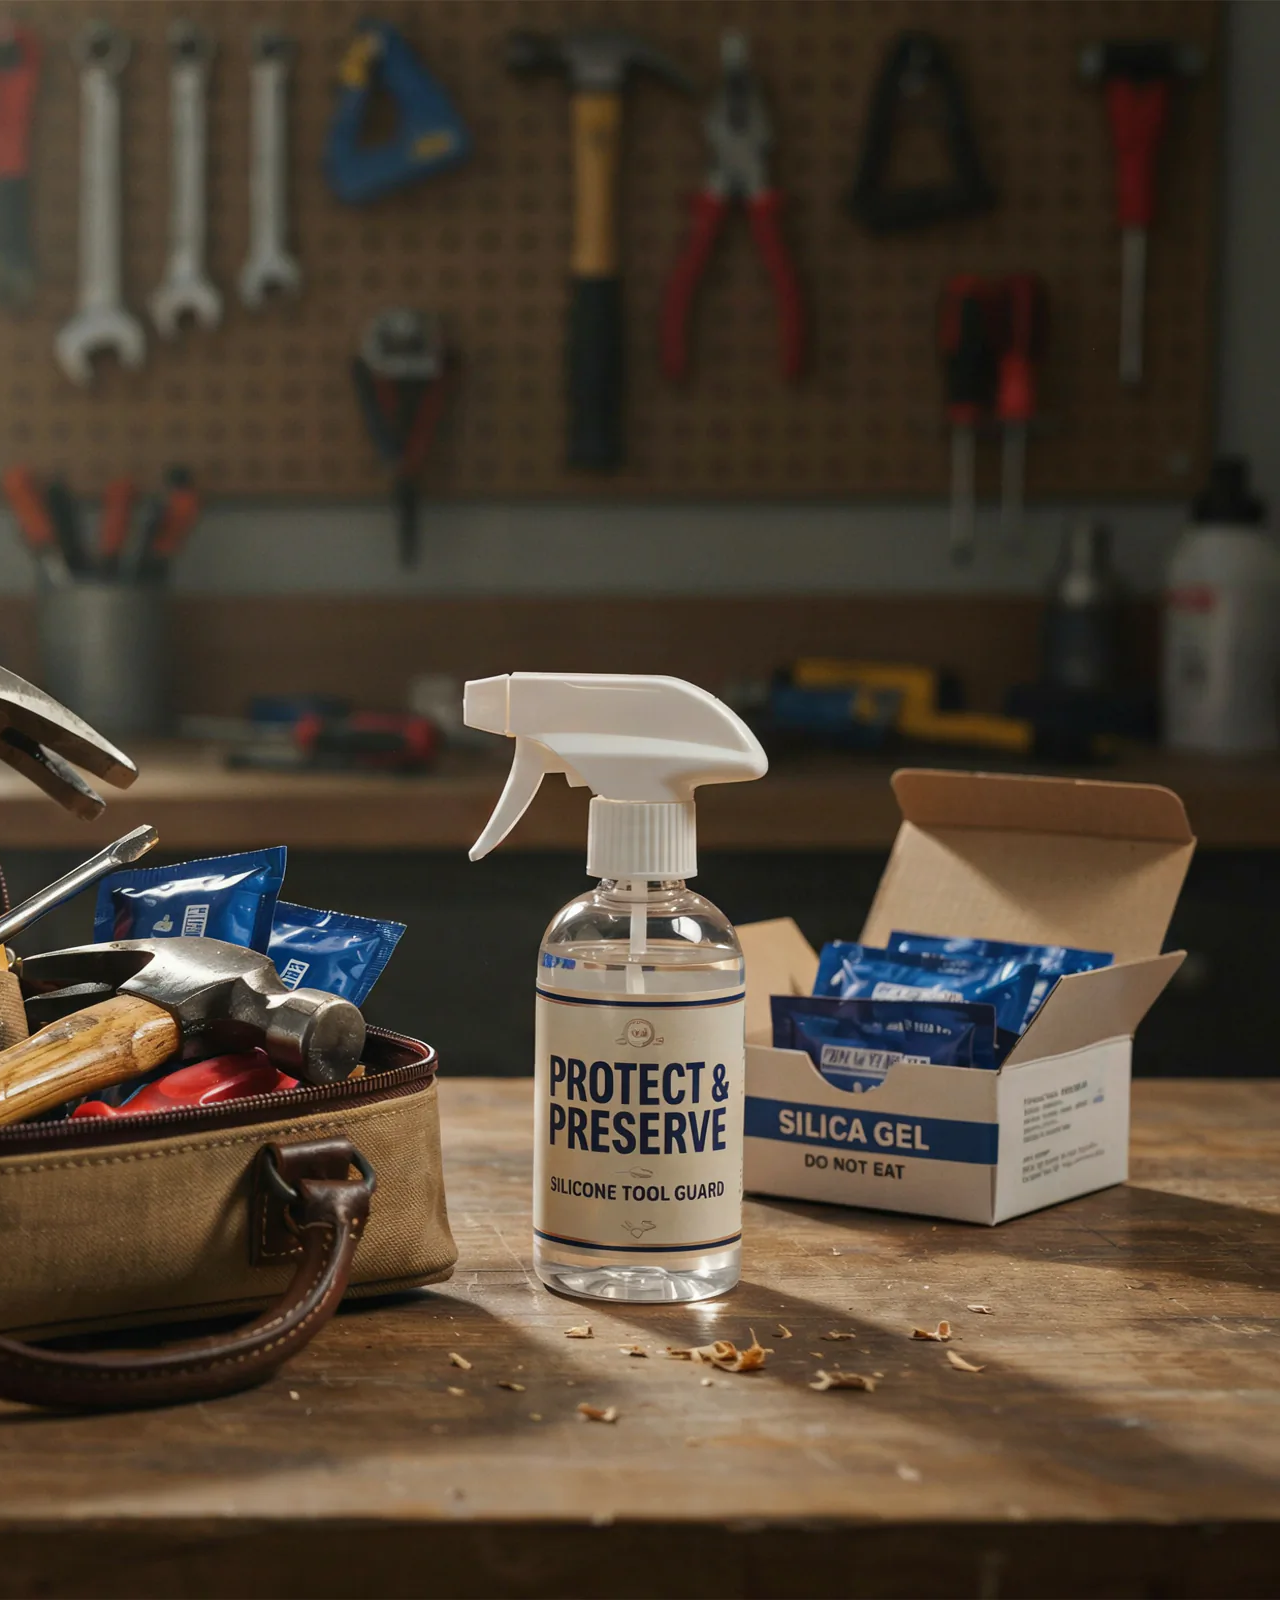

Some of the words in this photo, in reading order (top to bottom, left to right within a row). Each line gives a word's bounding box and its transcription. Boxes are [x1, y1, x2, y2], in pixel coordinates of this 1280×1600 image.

[549, 1054, 706, 1106] PROTECT
[711, 1063, 730, 1103] &
[549, 1102, 727, 1156] PRESERVE
[778, 1109, 868, 1144] SILICA
[873, 1121, 930, 1151] GEL
[804, 1153, 829, 1170] DO
[833, 1157, 868, 1175] NOT
[873, 1161, 906, 1181] EAT
[550, 1175, 617, 1201] SILICONE
[621, 1185, 671, 1202] TOOL
[674, 1180, 725, 1202] GUARD
